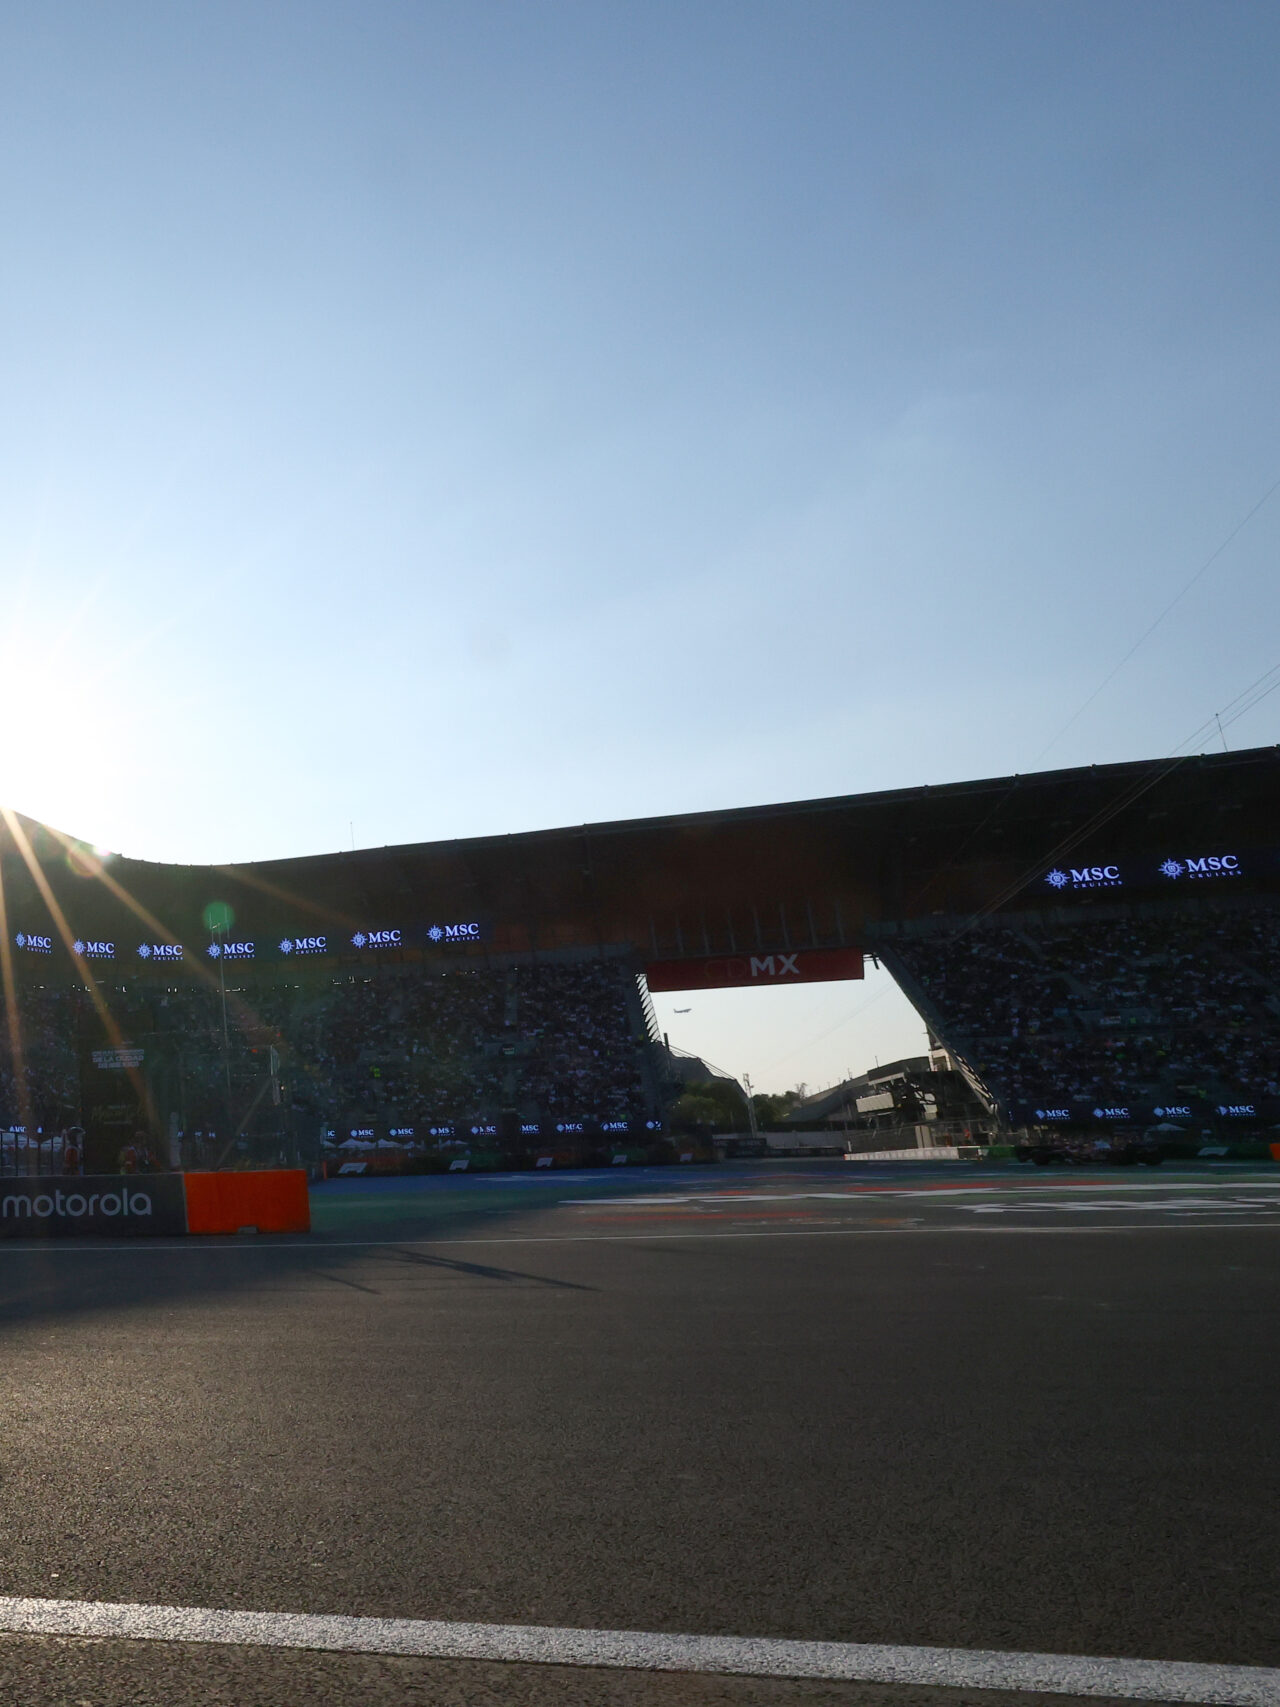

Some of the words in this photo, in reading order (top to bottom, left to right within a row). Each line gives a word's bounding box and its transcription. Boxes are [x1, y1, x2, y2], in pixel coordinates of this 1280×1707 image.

[1185, 855, 1238, 873] MSC
[1070, 865, 1120, 882] MSC
[1190, 870, 1242, 879] CRUISES
[1074, 880, 1123, 889] CRUISES
[444, 923, 479, 937] MSC
[27, 934, 51, 949] MSC
[295, 936, 326, 950] MSC
[368, 930, 401, 944] MSC
[87, 941, 114, 954] MSC
[153, 944, 183, 956] MSC
[224, 942, 254, 954] MSC
[1046, 1109, 1070, 1117] MSC
[1104, 1108, 1129, 1116] MSC
[1165, 1106, 1190, 1115] MSC
[1229, 1105, 1255, 1115] MSC
[521, 1124, 540, 1132] MSC
[2, 1188, 152, 1217] motorola
